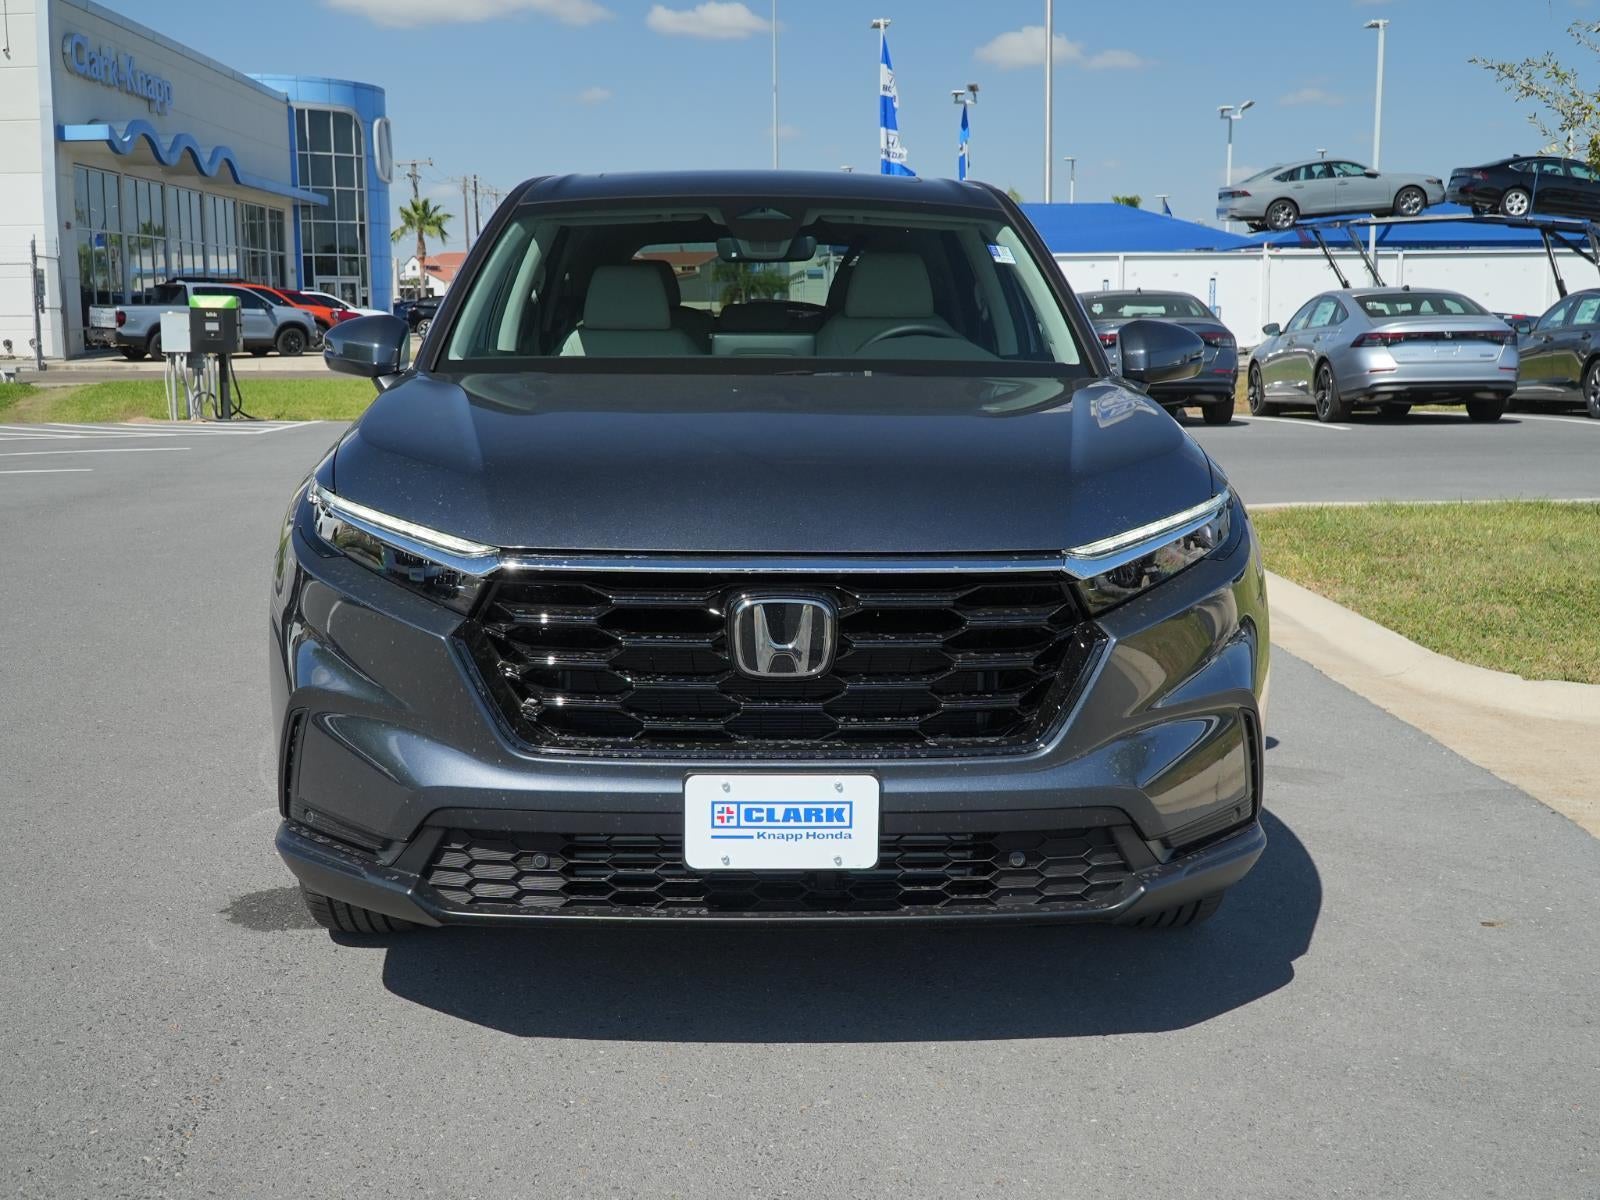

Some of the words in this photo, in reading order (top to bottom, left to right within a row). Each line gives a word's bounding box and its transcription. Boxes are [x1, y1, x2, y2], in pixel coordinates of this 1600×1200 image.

[743, 807, 846, 823] CLARK
[756, 831, 803, 842] Knapp
[806, 831, 852, 840] Honda
